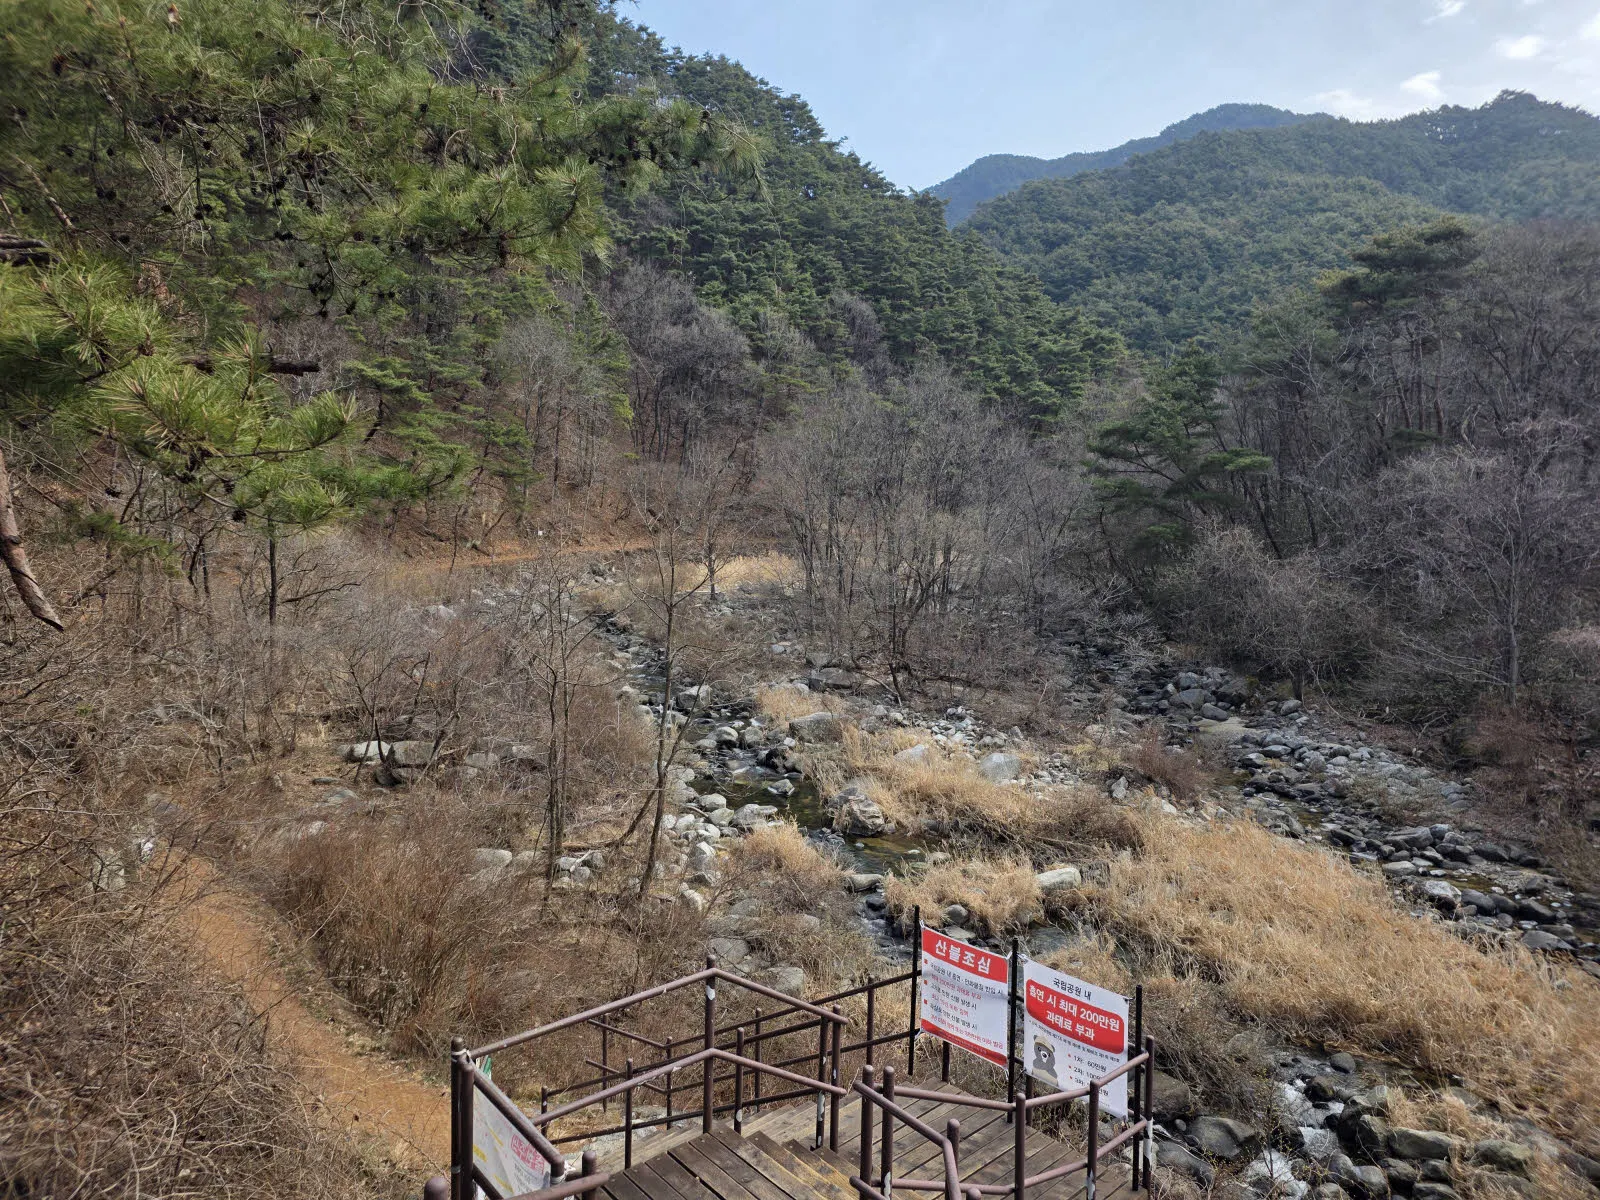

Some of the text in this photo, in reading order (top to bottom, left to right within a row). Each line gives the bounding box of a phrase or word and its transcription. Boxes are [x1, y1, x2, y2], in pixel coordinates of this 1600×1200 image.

[935, 939, 991, 974] 산불조심
[1053, 978, 1092, 1001] 국립공원 내
[1046, 1010, 1095, 1040] 과태료 부과
[1047, 994, 1057, 1008] 시
[1059, 1000, 1078, 1016] 최대
[1080, 1008, 1120, 1032] 200만원
